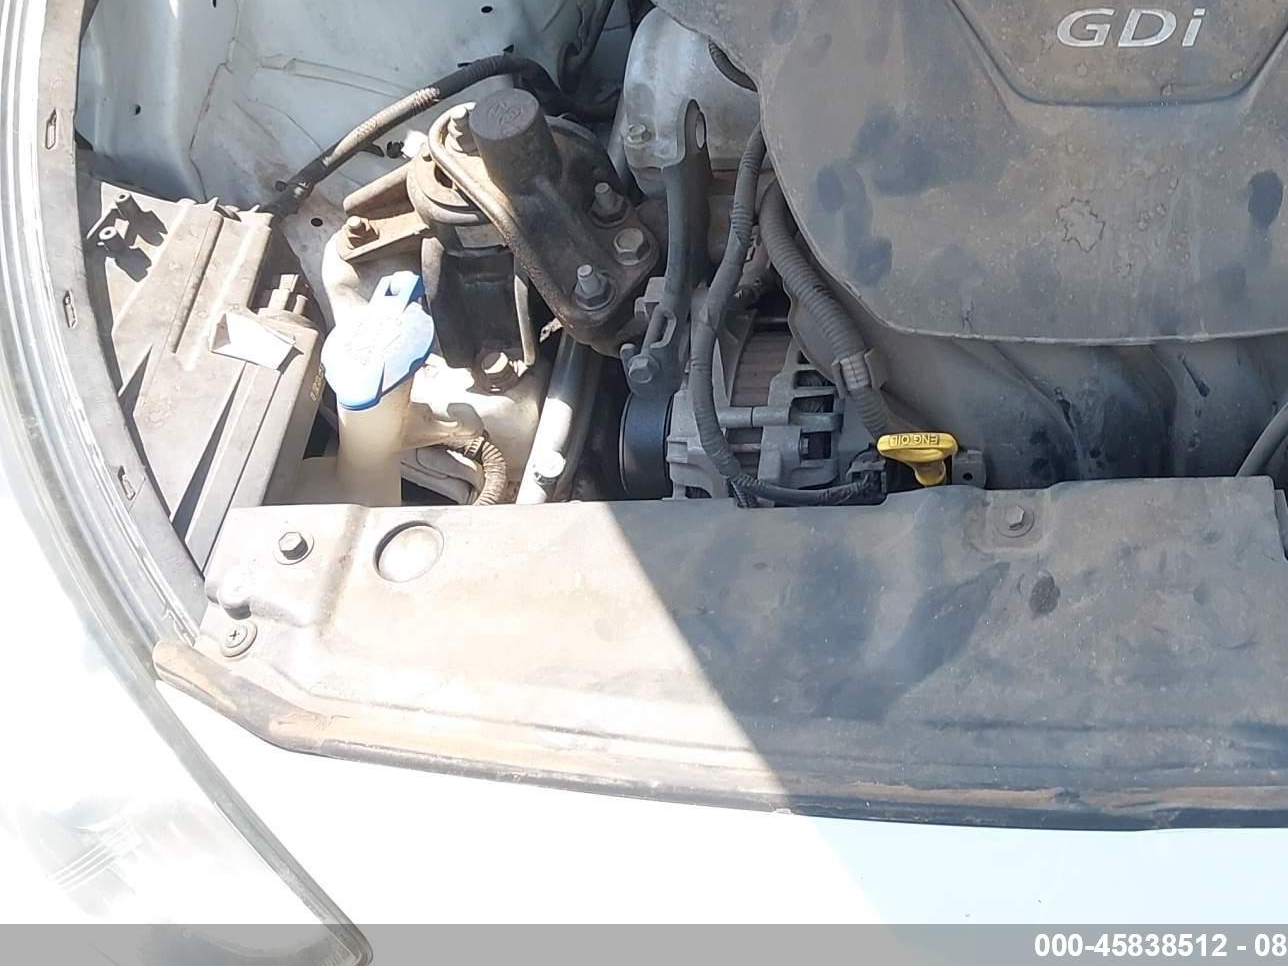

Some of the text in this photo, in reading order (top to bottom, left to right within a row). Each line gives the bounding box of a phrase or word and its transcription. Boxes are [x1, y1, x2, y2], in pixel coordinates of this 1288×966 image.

[1056, 7, 1207, 48] GDi
[890, 434, 939, 446] ENG OIL
